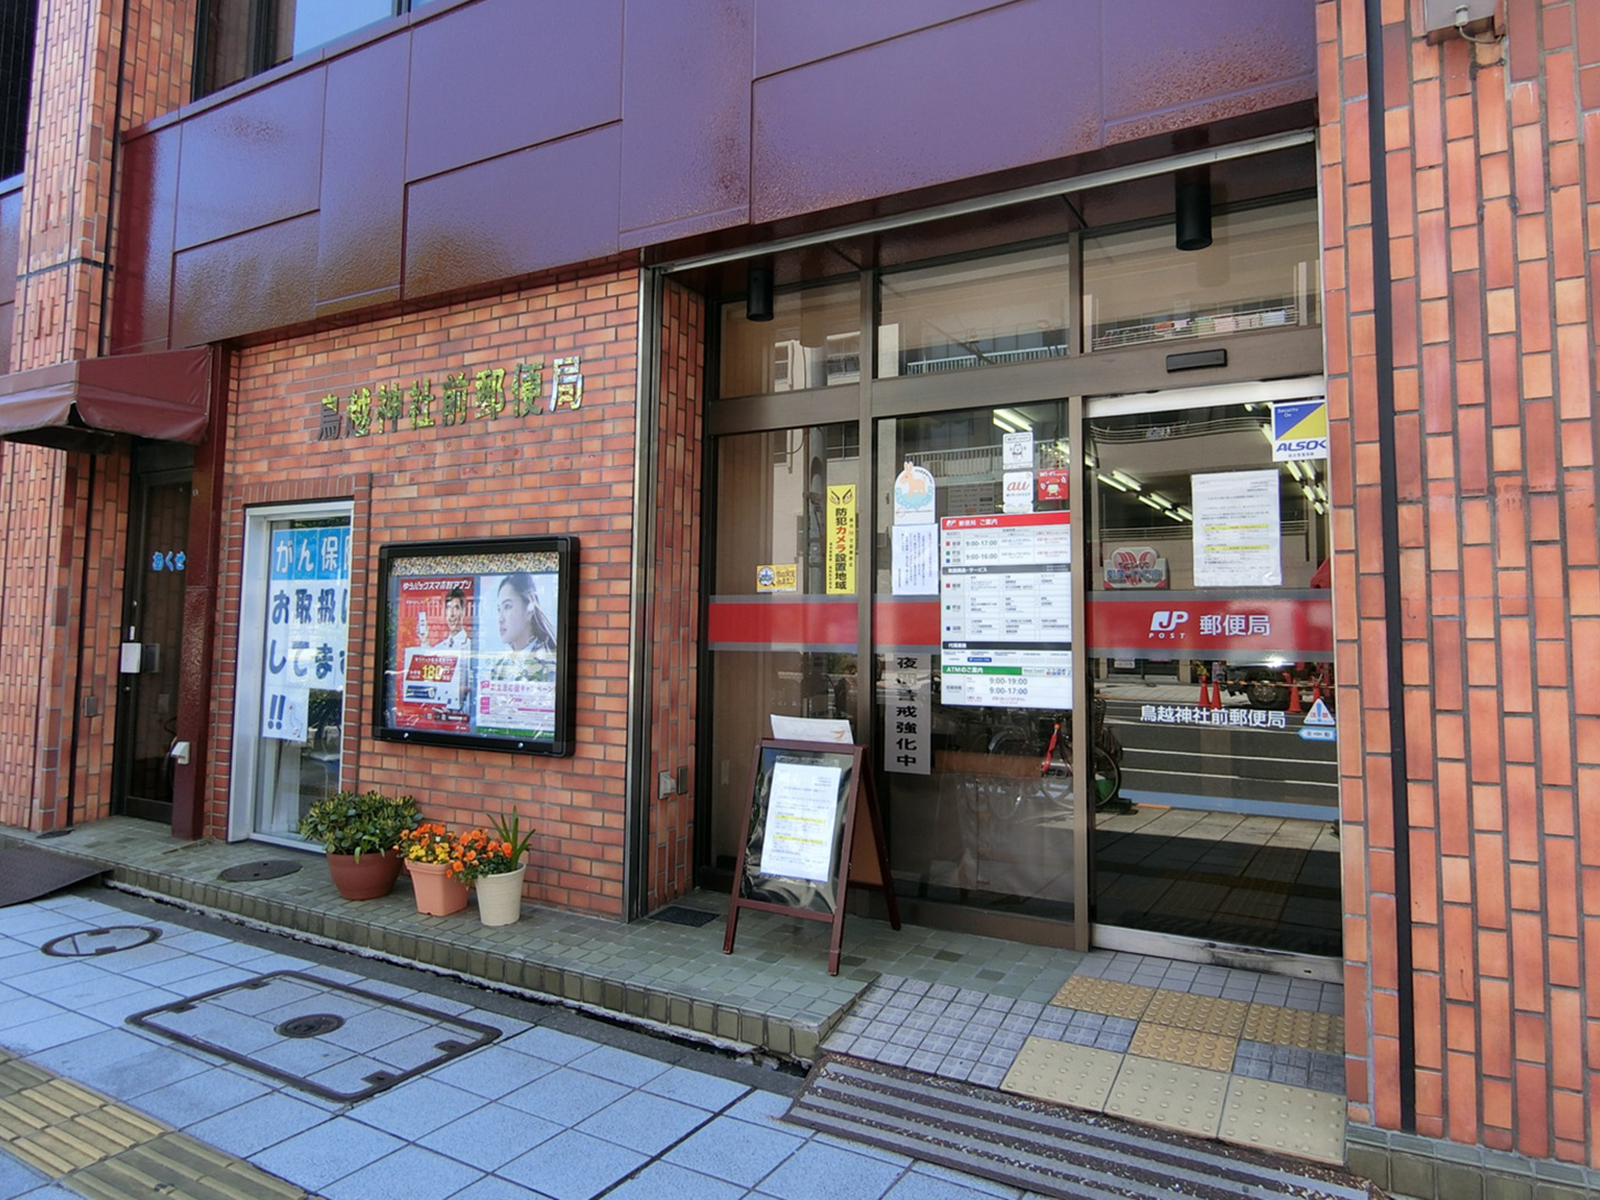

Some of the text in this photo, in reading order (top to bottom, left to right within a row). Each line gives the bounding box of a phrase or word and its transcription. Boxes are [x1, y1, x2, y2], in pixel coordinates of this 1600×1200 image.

[318, 355, 583, 441] 鳥越神社前郵便局
[1276, 439, 1327, 452] ALSOK
[1006, 481, 1030, 492] au
[834, 507, 848, 590] 防犯カメラ設置地域
[966, 539, 998, 547] 9:00-17:00
[1199, 614, 1271, 637] 郵便局
[989, 677, 1028, 685] 9:00-19:00
[989, 686, 1028, 695] 9:00-17:00
[1140, 704, 1286, 728] 鳥越神社前郵便局
